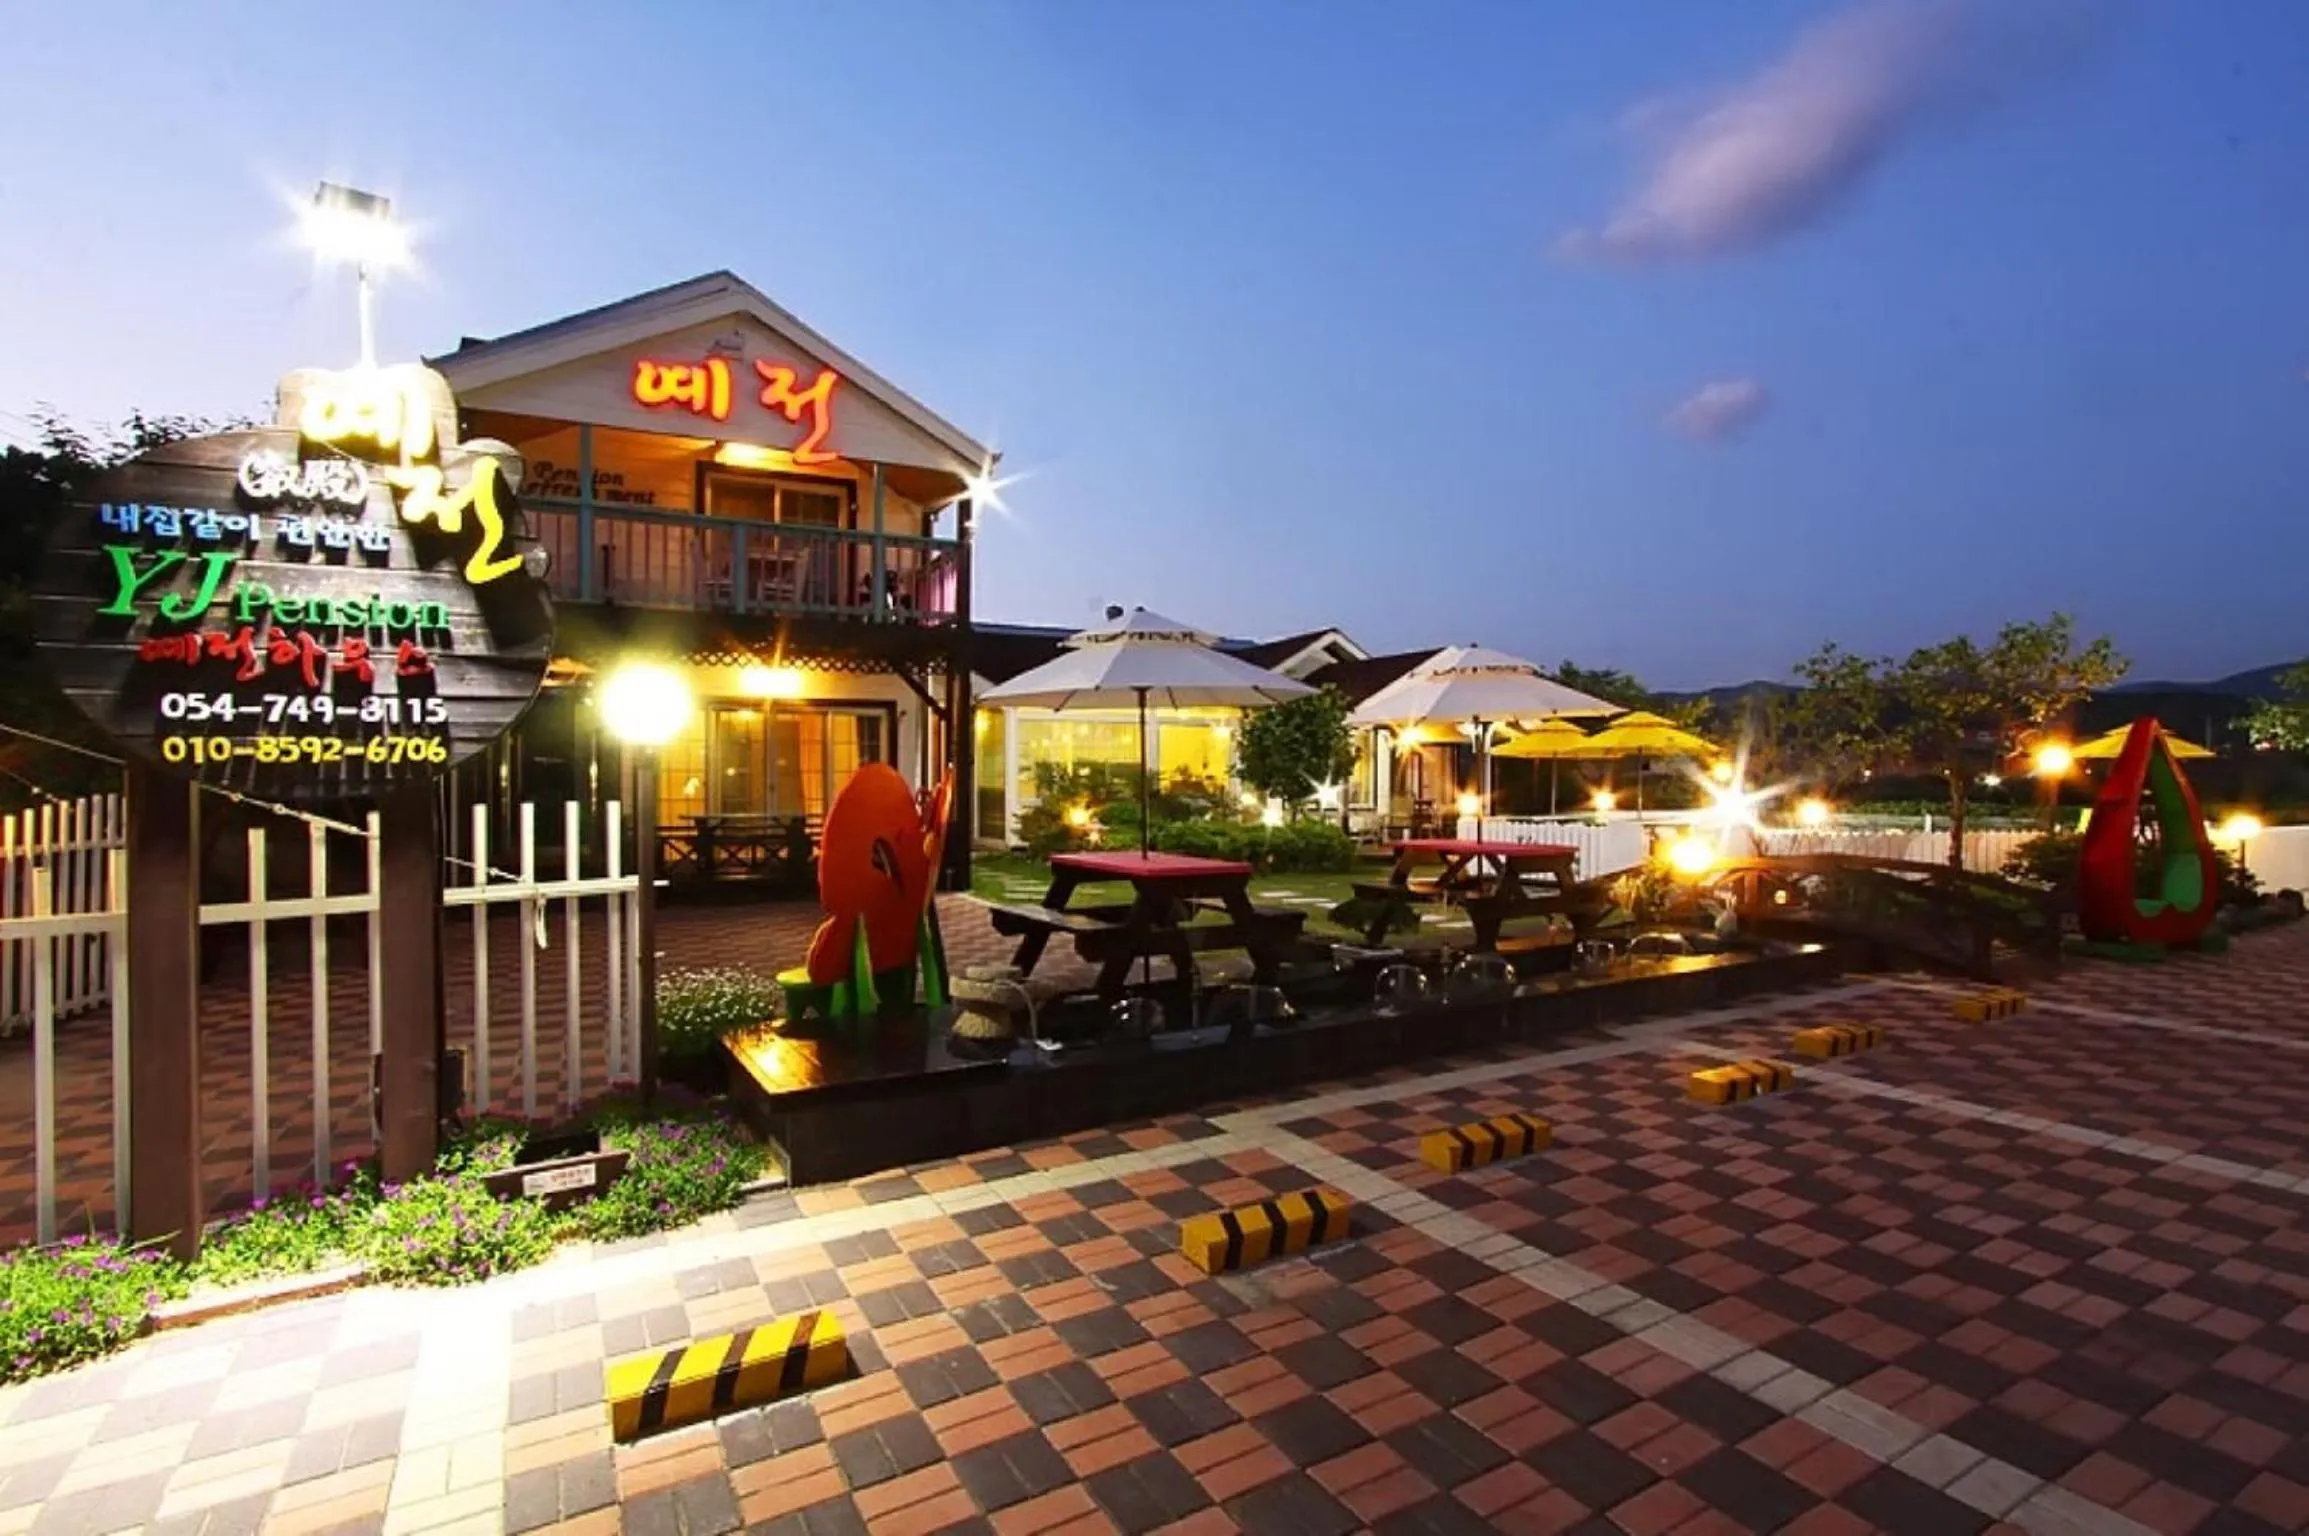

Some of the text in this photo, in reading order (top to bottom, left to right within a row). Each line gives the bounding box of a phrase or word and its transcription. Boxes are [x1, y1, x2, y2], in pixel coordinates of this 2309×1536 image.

[533, 460, 624, 486] Penion
[98, 545, 450, 629] YJ Pension
[160, 692, 448, 723] 054-749-8115
[162, 735, 448, 764] 010-8592-6706
